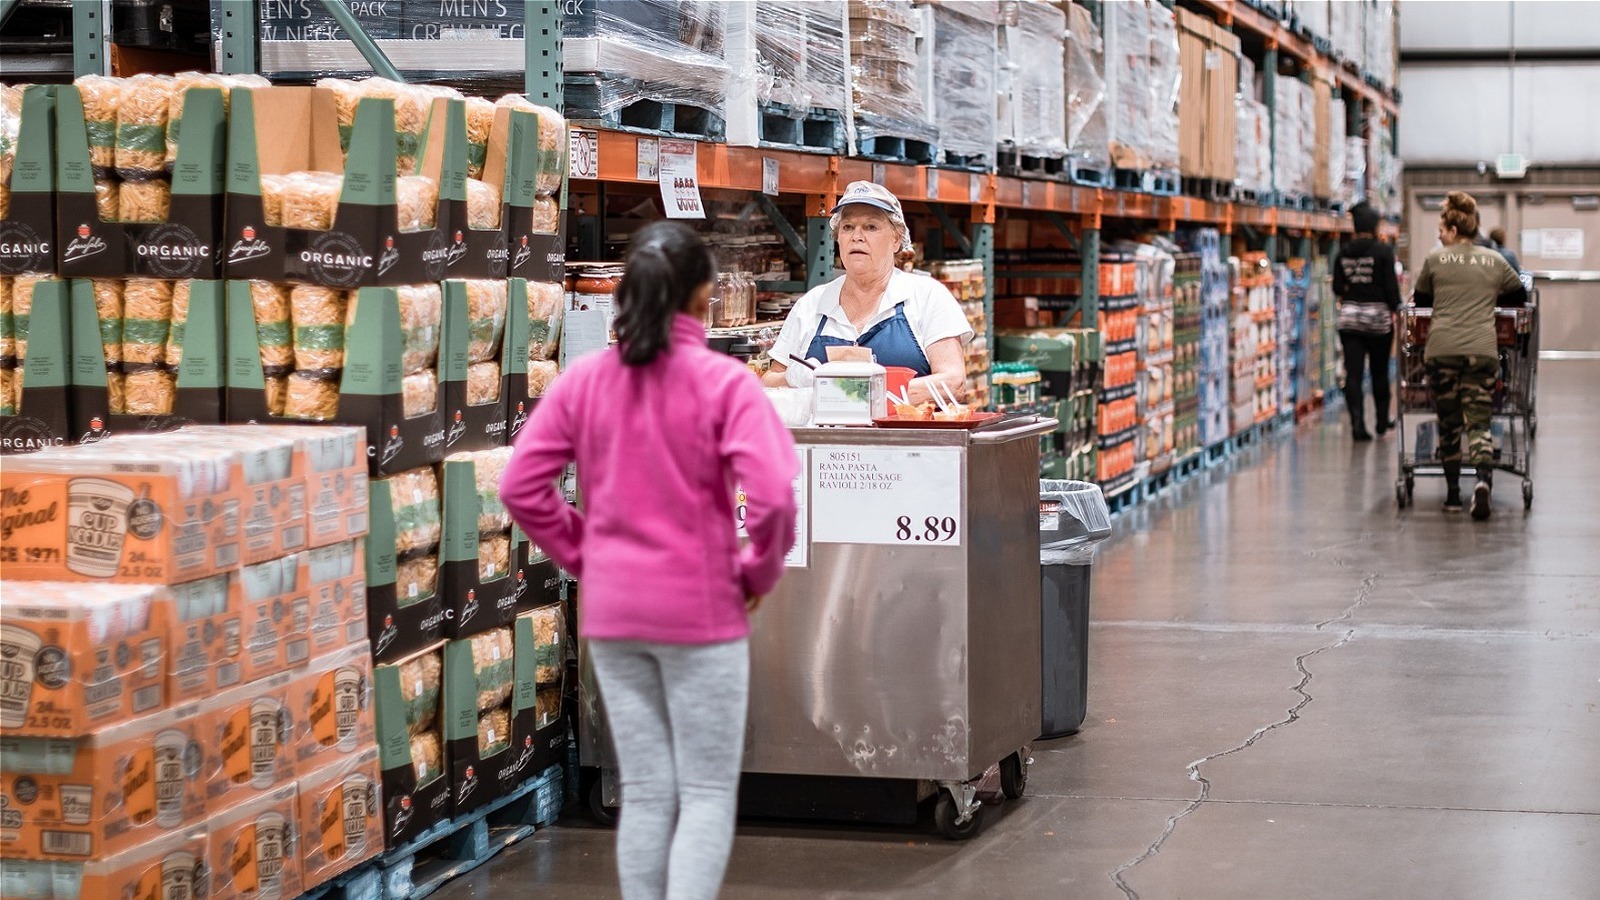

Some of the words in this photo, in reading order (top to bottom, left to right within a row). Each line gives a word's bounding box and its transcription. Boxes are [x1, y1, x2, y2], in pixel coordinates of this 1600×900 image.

[261, 0, 312, 19] EN'S
[351, 1, 388, 17] PACK
[440, 0, 508, 18] MEN'S
[0, 242, 50, 254] GANIC
[137, 244, 210, 257] ORGANIC
[422, 247, 449, 262] ORGANIC
[486, 249, 511, 260] ORGANIC
[301, 251, 373, 268] ORGANIC
[546, 252, 566, 263] ORGANIC
[1440, 253, 1466, 265] GIVE
[1470, 255, 1478, 265] A
[485, 420, 507, 434] ORGANIC
[423, 430, 446, 446] ORGANIC
[829, 452, 861, 462] 805151
[819, 463, 845, 472] RANA
[848, 463, 878, 472] PASTA
[819, 472, 857, 481] ITALIAN
[859, 473, 903, 482] SAUSAGE
[819, 481, 857, 490] RAVIOLI
[859, 482, 878, 490] 2/18
[879, 482, 893, 490] OZ
[0, 501, 58, 540] ginal
[896, 515, 957, 542] 8.89
[24, 546, 61, 563] 1971
[145, 566, 163, 578] OZ
[0, 660, 25, 680] UP
[51, 717, 72, 729] OZ
